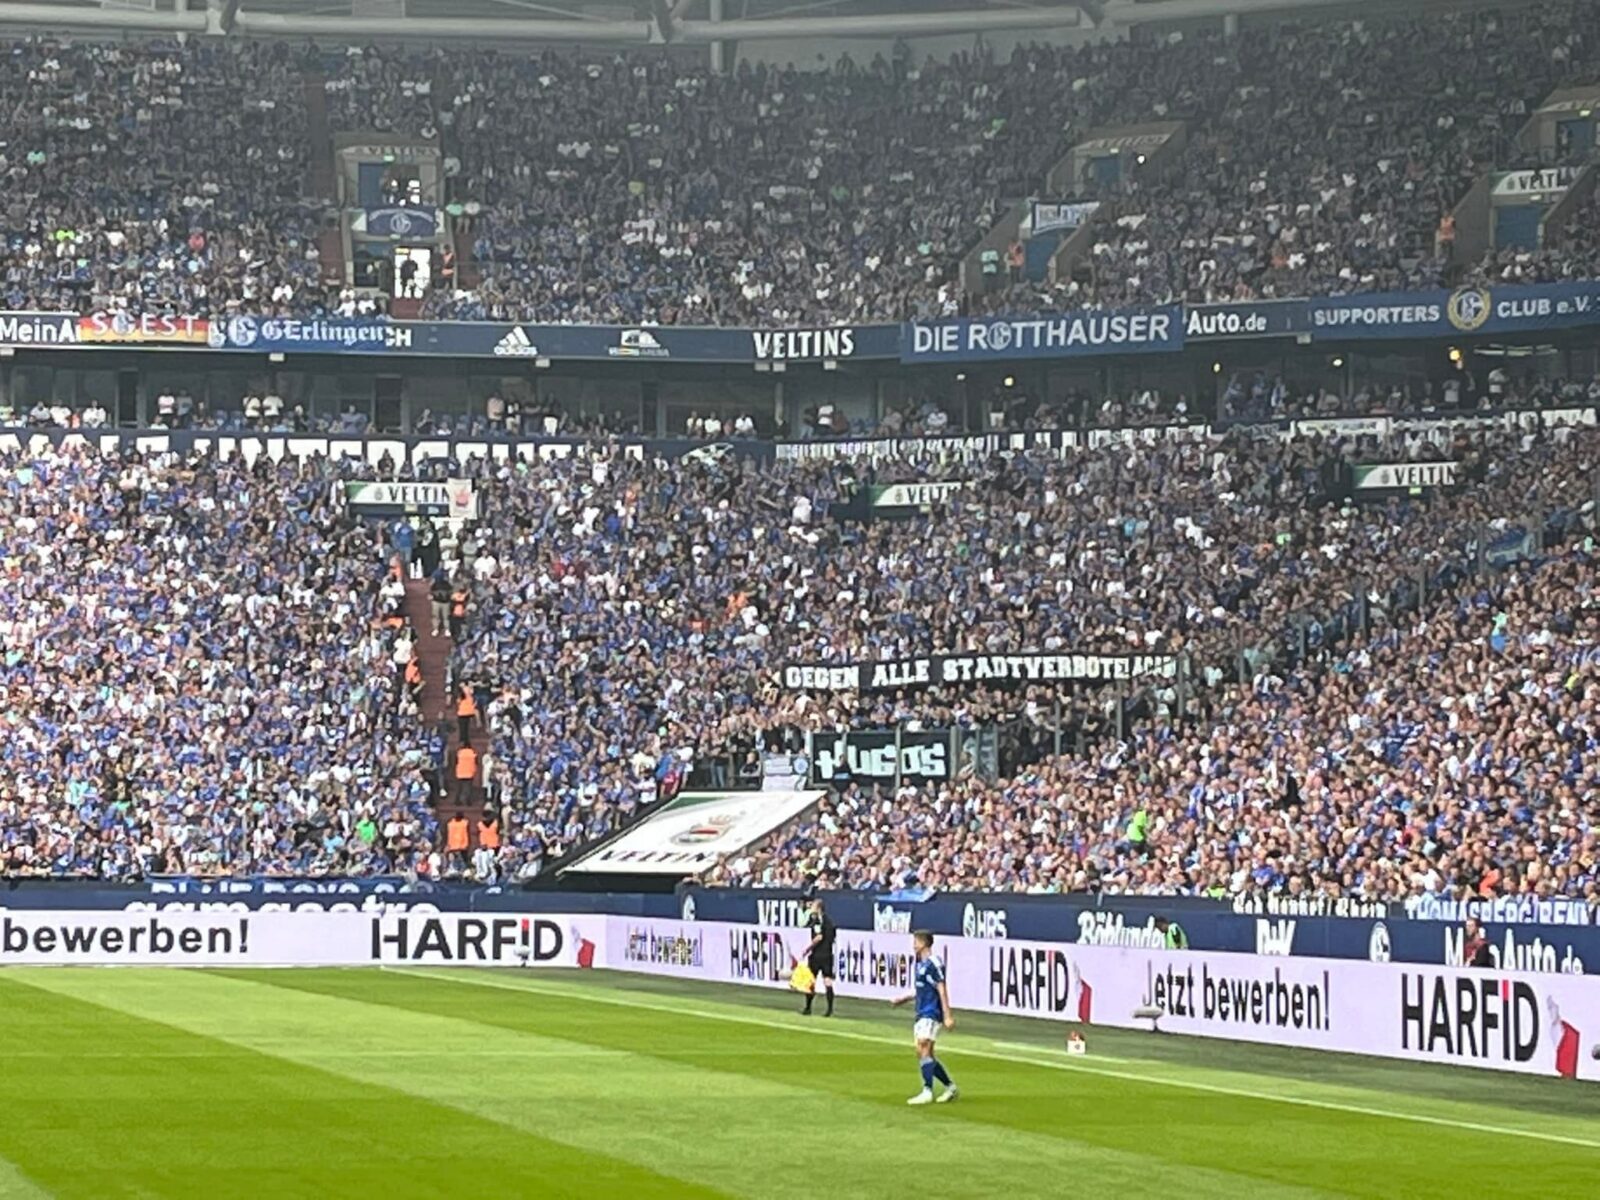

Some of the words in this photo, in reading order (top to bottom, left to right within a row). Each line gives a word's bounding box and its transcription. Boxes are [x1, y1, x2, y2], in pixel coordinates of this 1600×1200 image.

[1187, 311, 1267, 335] Auto.de
[1314, 305, 1440, 326] SUPPORTERS
[1497, 299, 1550, 318] CLUB
[753, 329, 854, 358] VELTINS
[914, 324, 959, 353] DIE
[785, 665, 860, 689] GEGEN
[872, 659, 930, 687] ALLE
[3, 917, 249, 954] bewerben!
[372, 918, 564, 961] HARFID
[729, 928, 784, 982] HARFID
[836, 940, 865, 985] etzt
[990, 946, 1070, 1012] HARFID
[1142, 959, 1196, 1018] Jetzt
[1203, 961, 1330, 1031] bewerben!
[1401, 972, 1540, 1062] HARFID
